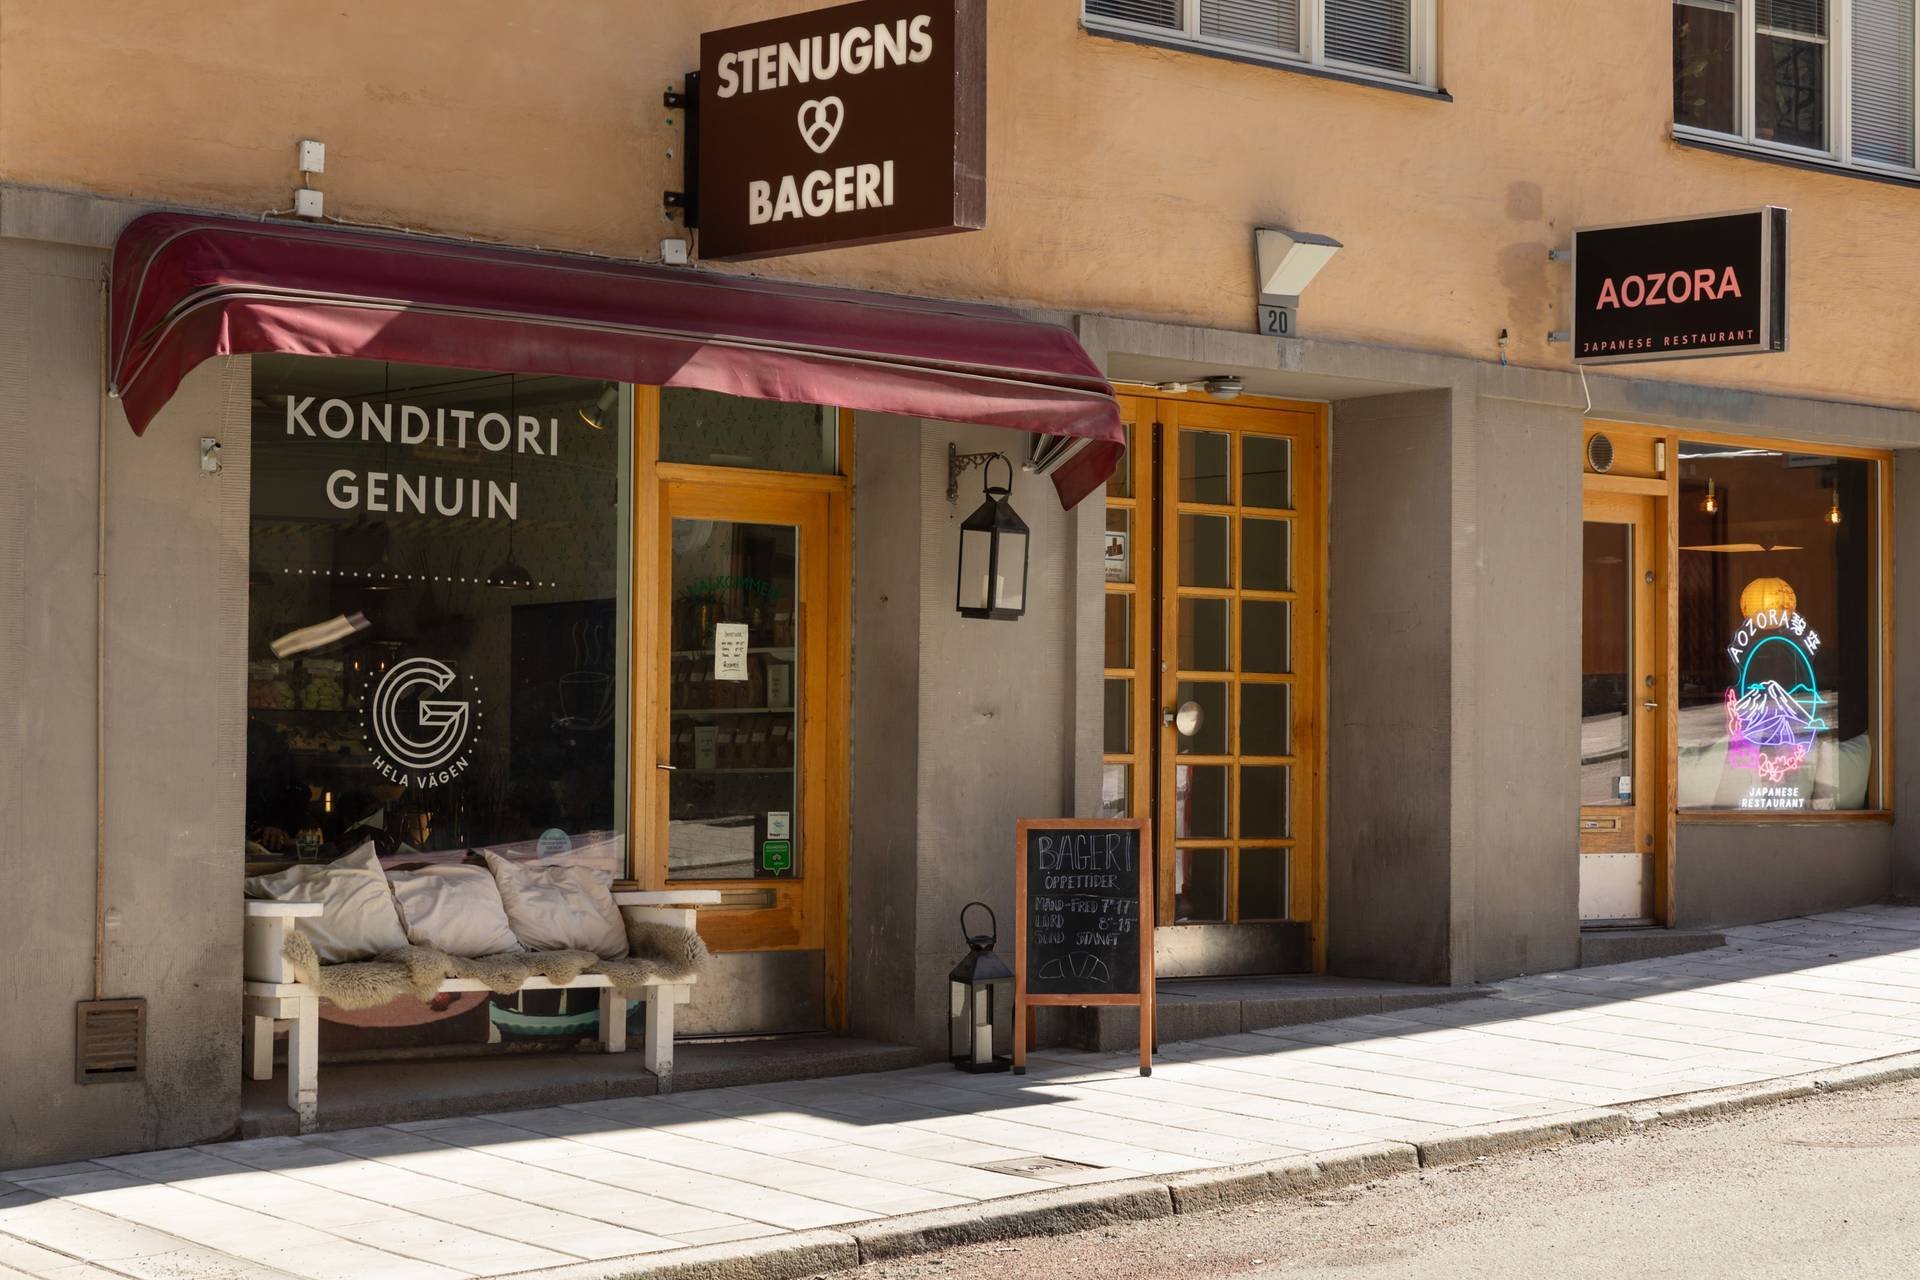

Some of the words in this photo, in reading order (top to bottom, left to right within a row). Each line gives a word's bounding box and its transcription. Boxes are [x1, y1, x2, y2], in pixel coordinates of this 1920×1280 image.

[717, 14, 933, 98] STENUGNS
[749, 160, 894, 225] BAGERI
[1596, 266, 1742, 310] AOZORA
[1269, 310, 1287, 333] 20
[1584, 337, 1652, 352] JAPANESE
[1664, 329, 1754, 346] RESTAURANT
[286, 395, 558, 456] KONDITORI
[326, 469, 518, 520] GENUIN
[372, 755, 409, 787] HELA
[417, 756, 469, 789] VÄGEN
[1742, 798, 1804, 808] RESTAURANT
[1749, 787, 1799, 797] JAPANESE
[1038, 833, 1131, 872] BAGERI
[1045, 871, 1120, 889] ÖPPETTIDER
